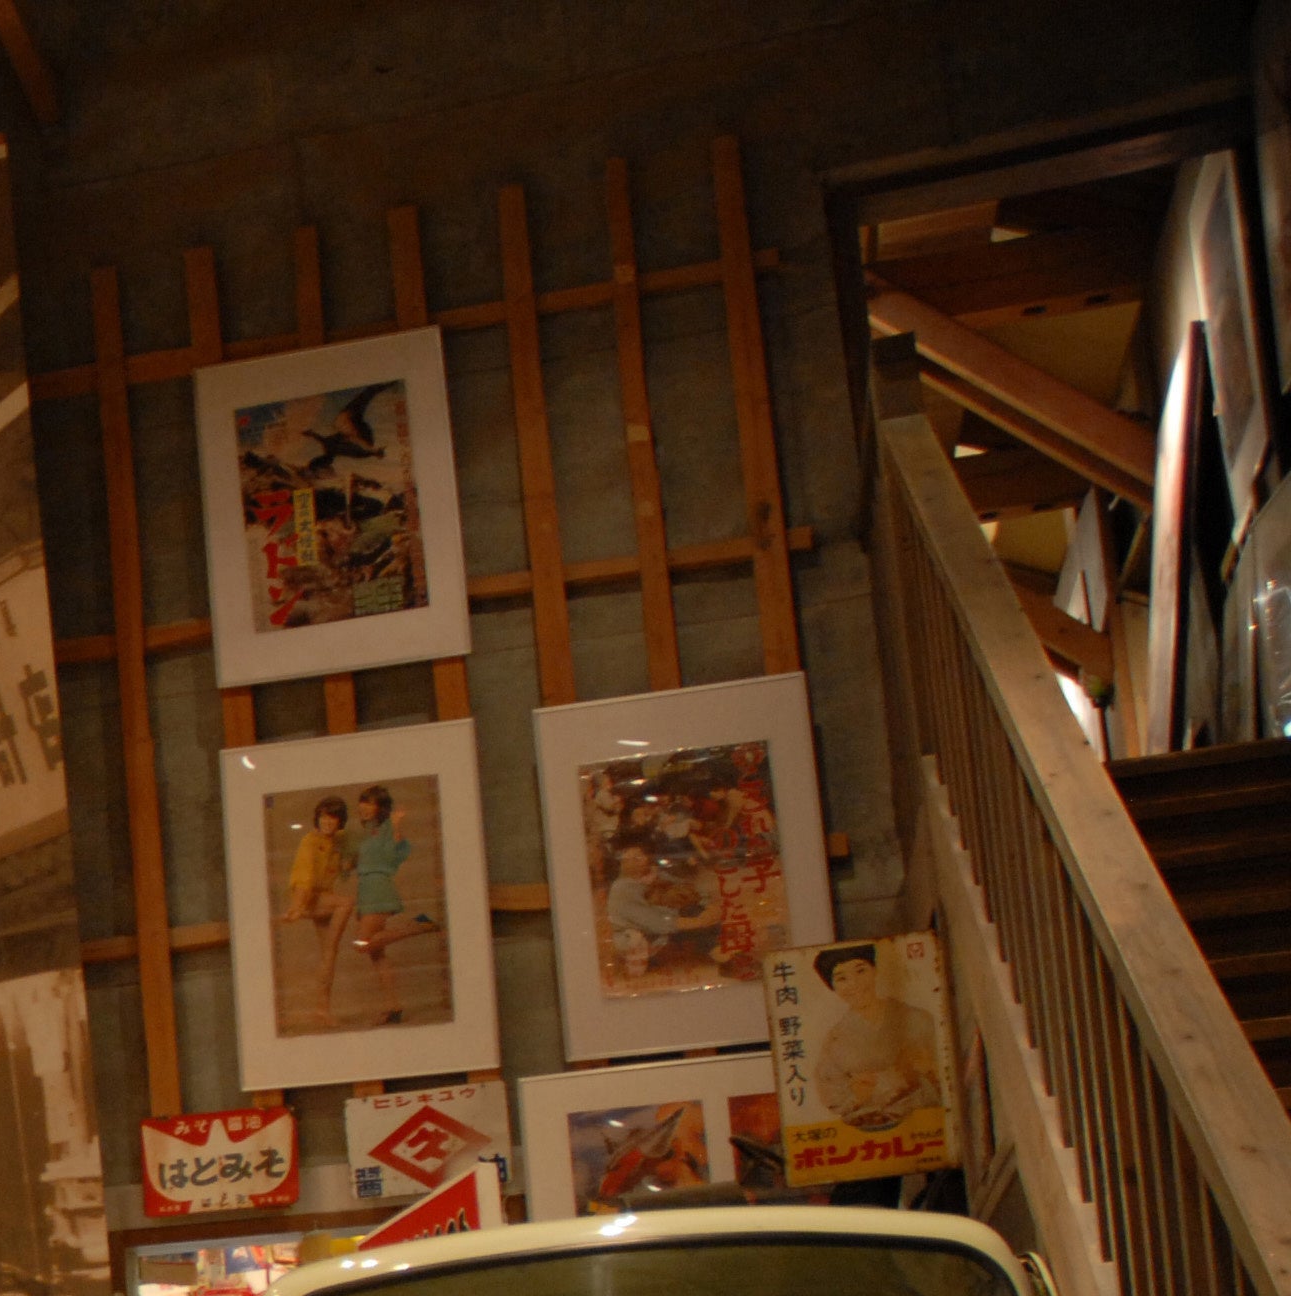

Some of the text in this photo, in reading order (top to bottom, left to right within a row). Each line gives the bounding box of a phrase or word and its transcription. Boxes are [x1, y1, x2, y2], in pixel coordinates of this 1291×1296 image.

[252, 488, 305, 626] ラドン
[772, 961, 807, 1107] 牛肉 野菜入り
[158, 1148, 287, 1190] はとみそ
[793, 1135, 945, 1171] ボンカレー
